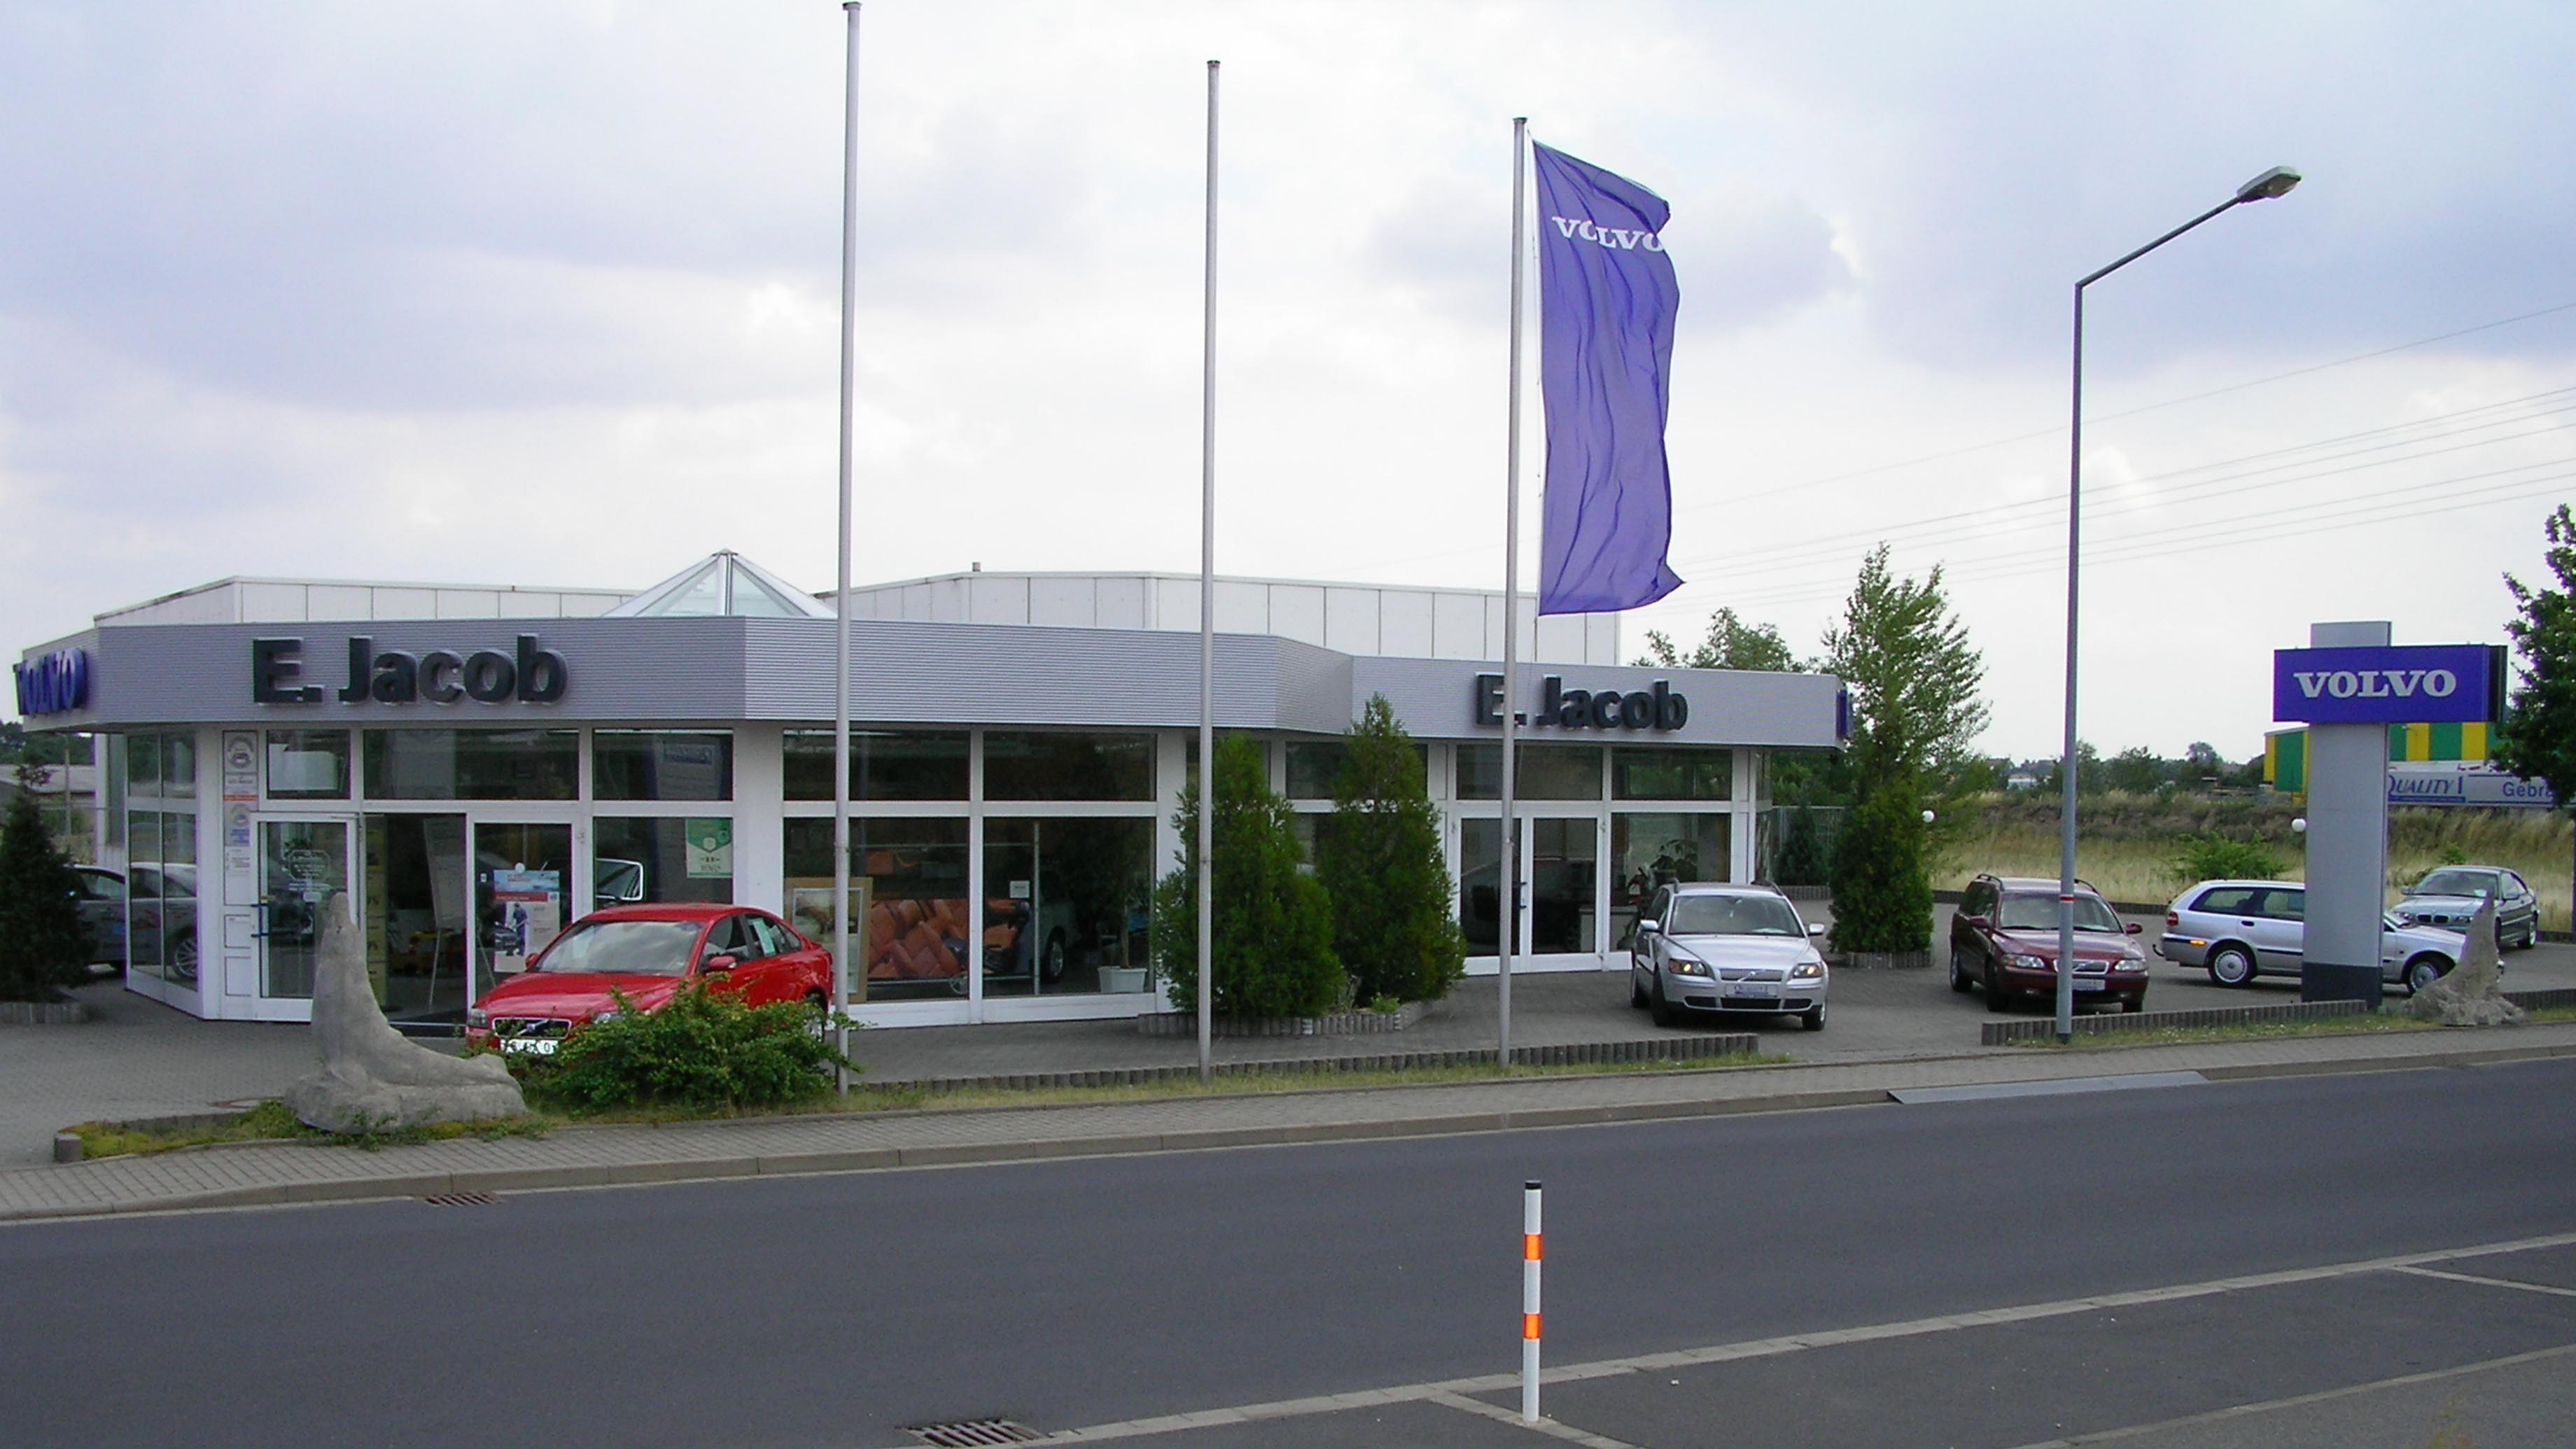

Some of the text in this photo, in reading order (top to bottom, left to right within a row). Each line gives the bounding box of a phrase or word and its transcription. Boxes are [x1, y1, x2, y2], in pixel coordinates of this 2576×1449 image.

[253, 633, 568, 705] E. Jacob
[2293, 669, 2456, 698] VOLVO
[1475, 672, 1688, 729] E. Jacob
